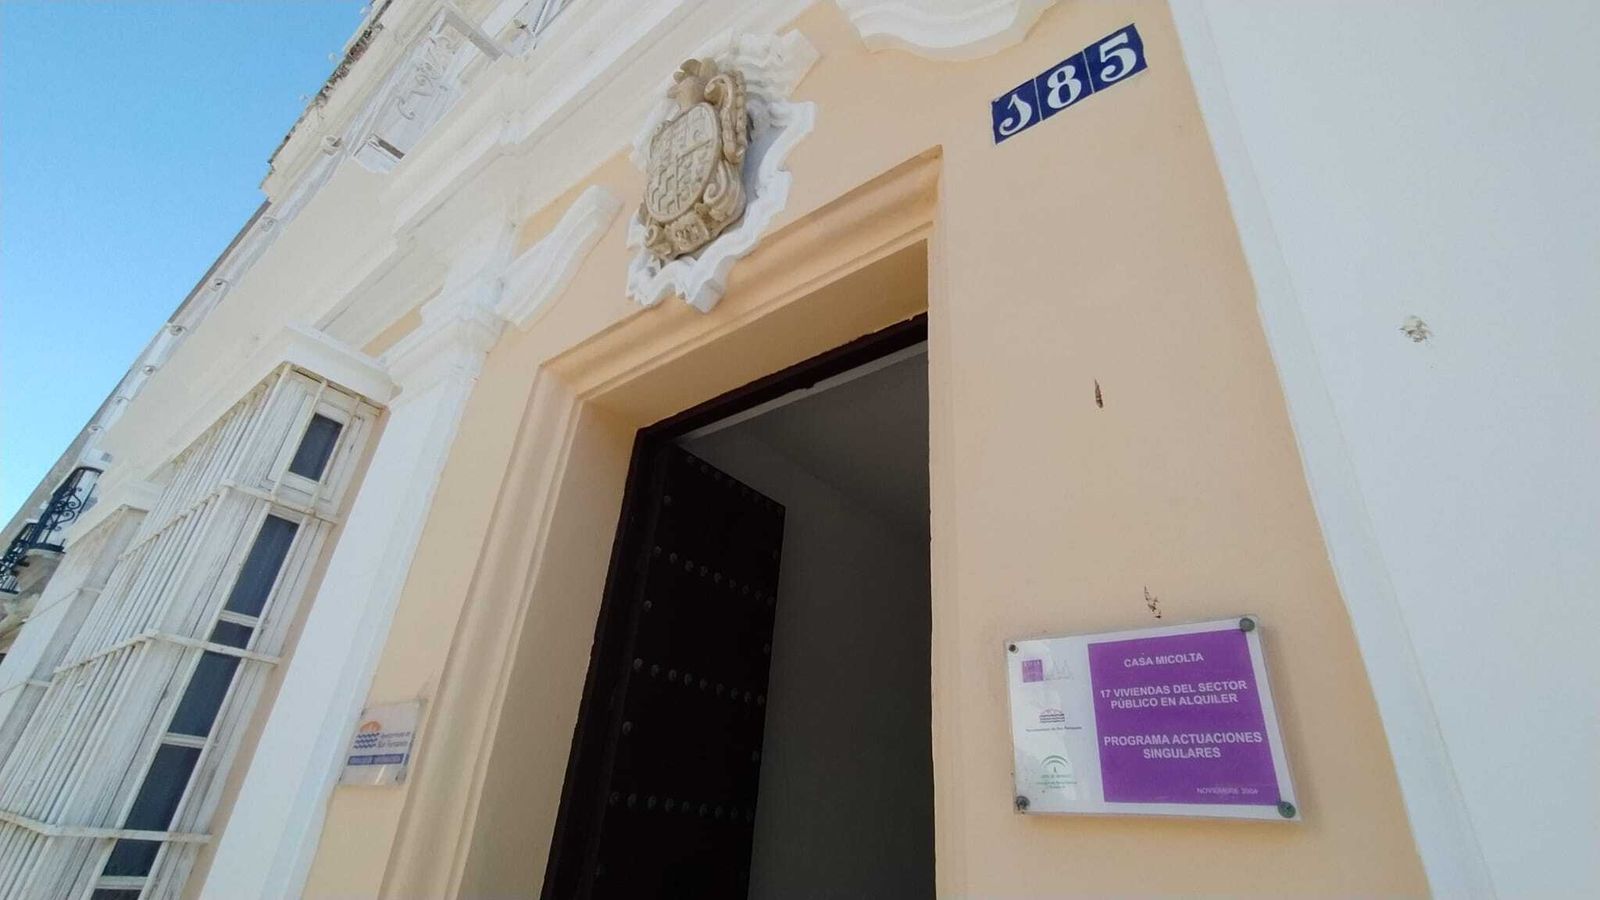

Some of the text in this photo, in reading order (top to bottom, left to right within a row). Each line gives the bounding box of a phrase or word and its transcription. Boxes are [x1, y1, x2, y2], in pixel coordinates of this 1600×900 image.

[998, 32, 1137, 136] 185
[1123, 652, 1204, 668] CASA MICOLTA
[1100, 680, 1248, 698] 17 VIVIENDAS DEL SECTOR
[1111, 693, 1238, 709] PÚBLICO EN ALQUILER
[1104, 731, 1263, 746] PROGRAMA ACTUACIONES
[1143, 746, 1222, 759] SINGULARES
